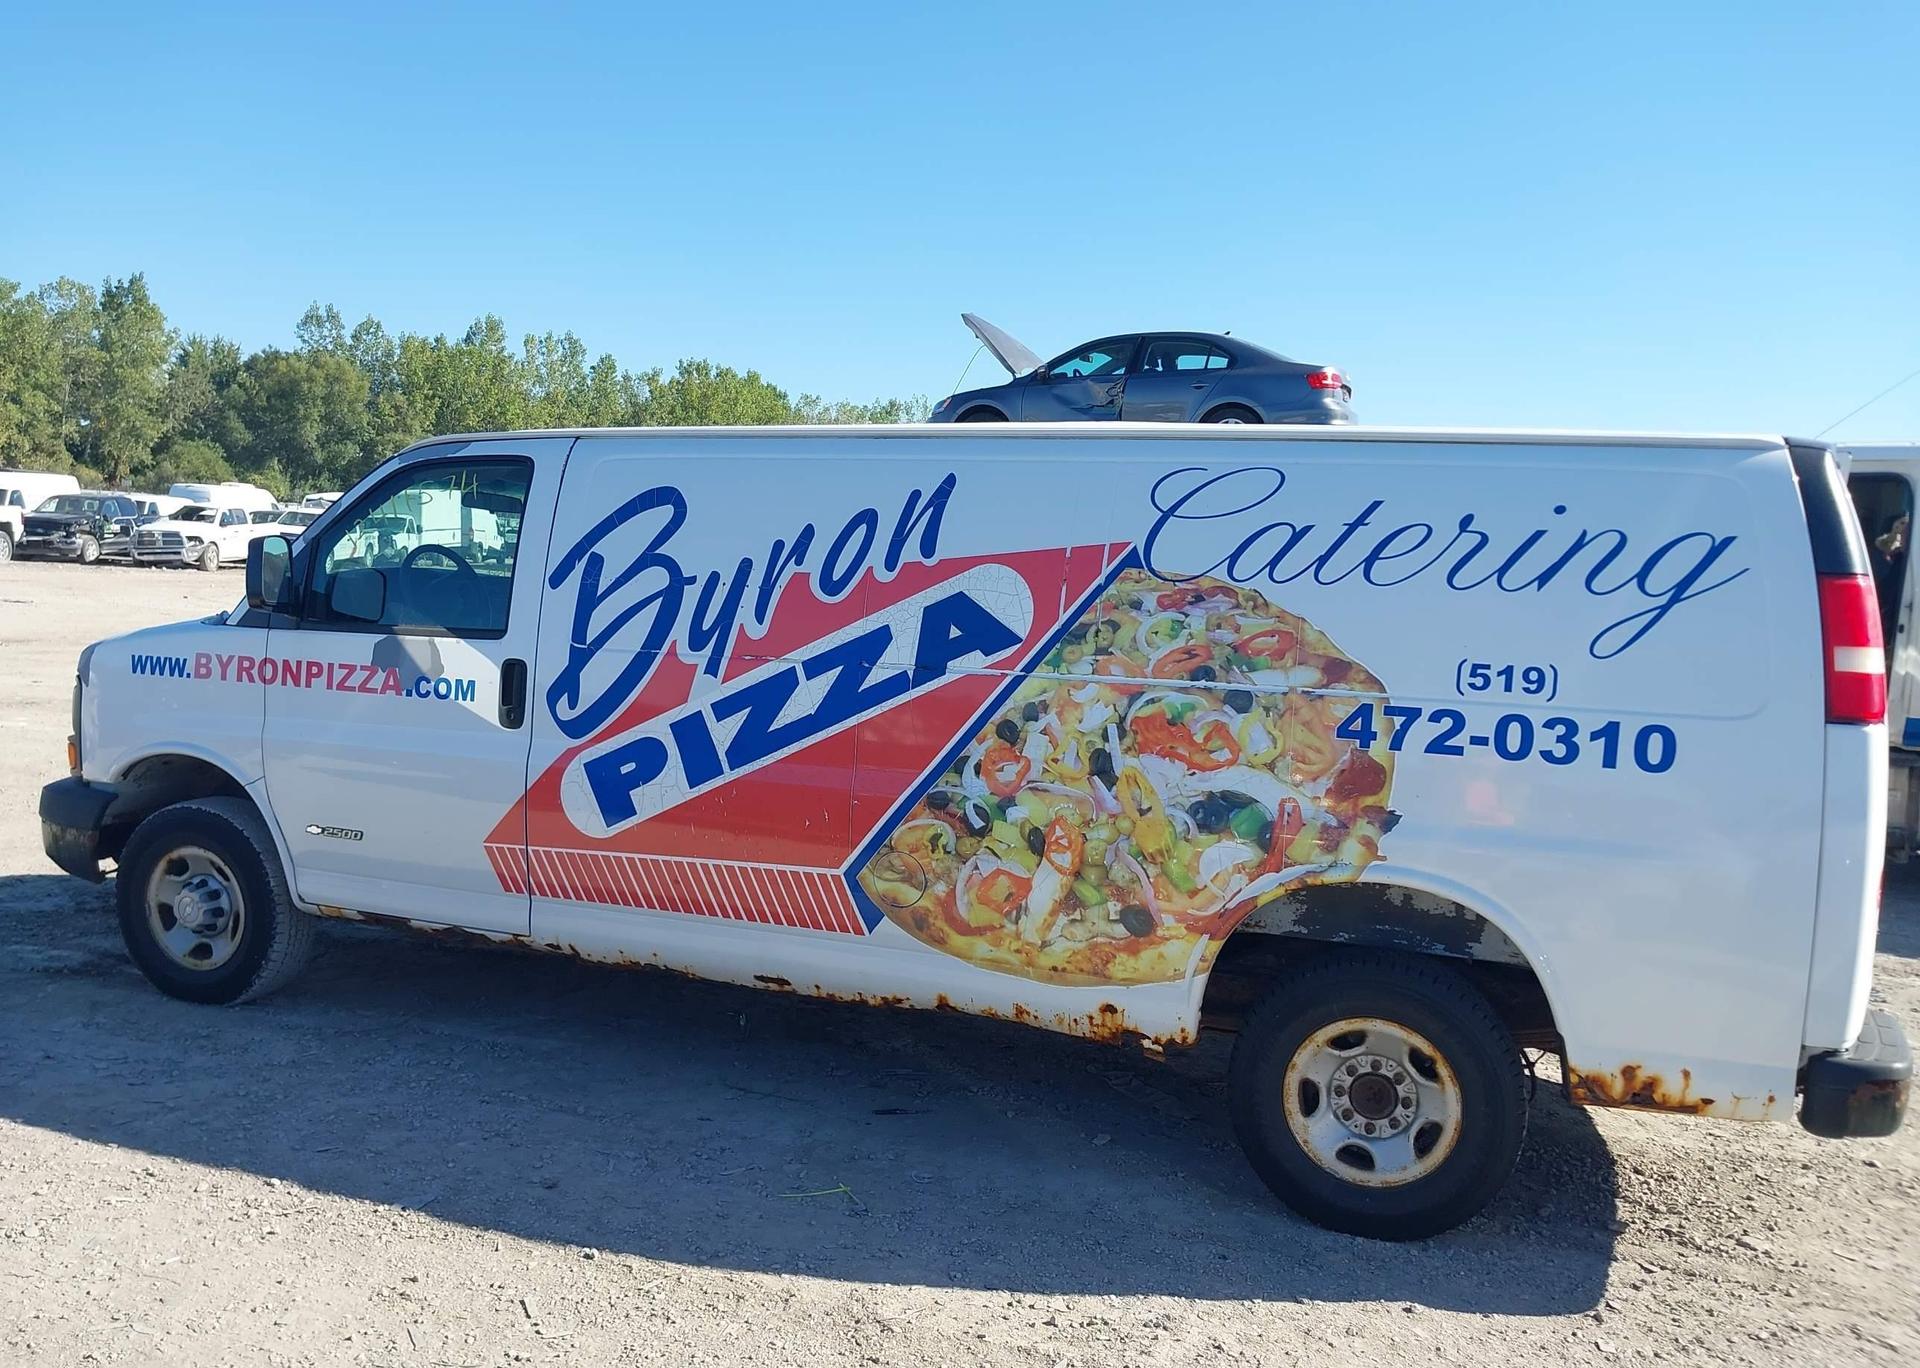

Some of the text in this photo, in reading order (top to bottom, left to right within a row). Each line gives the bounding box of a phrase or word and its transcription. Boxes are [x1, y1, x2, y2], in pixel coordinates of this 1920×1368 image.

[1142, 466, 1749, 659] Catering
[546, 472, 957, 740] Byron
[131, 652, 476, 702] WWW.BYRONPIZZA.COM
[583, 590, 1024, 828] PIZZA
[1456, 658, 1558, 702] (519)
[1336, 703, 1677, 774] 472-0310
[323, 827, 363, 841] 2500
